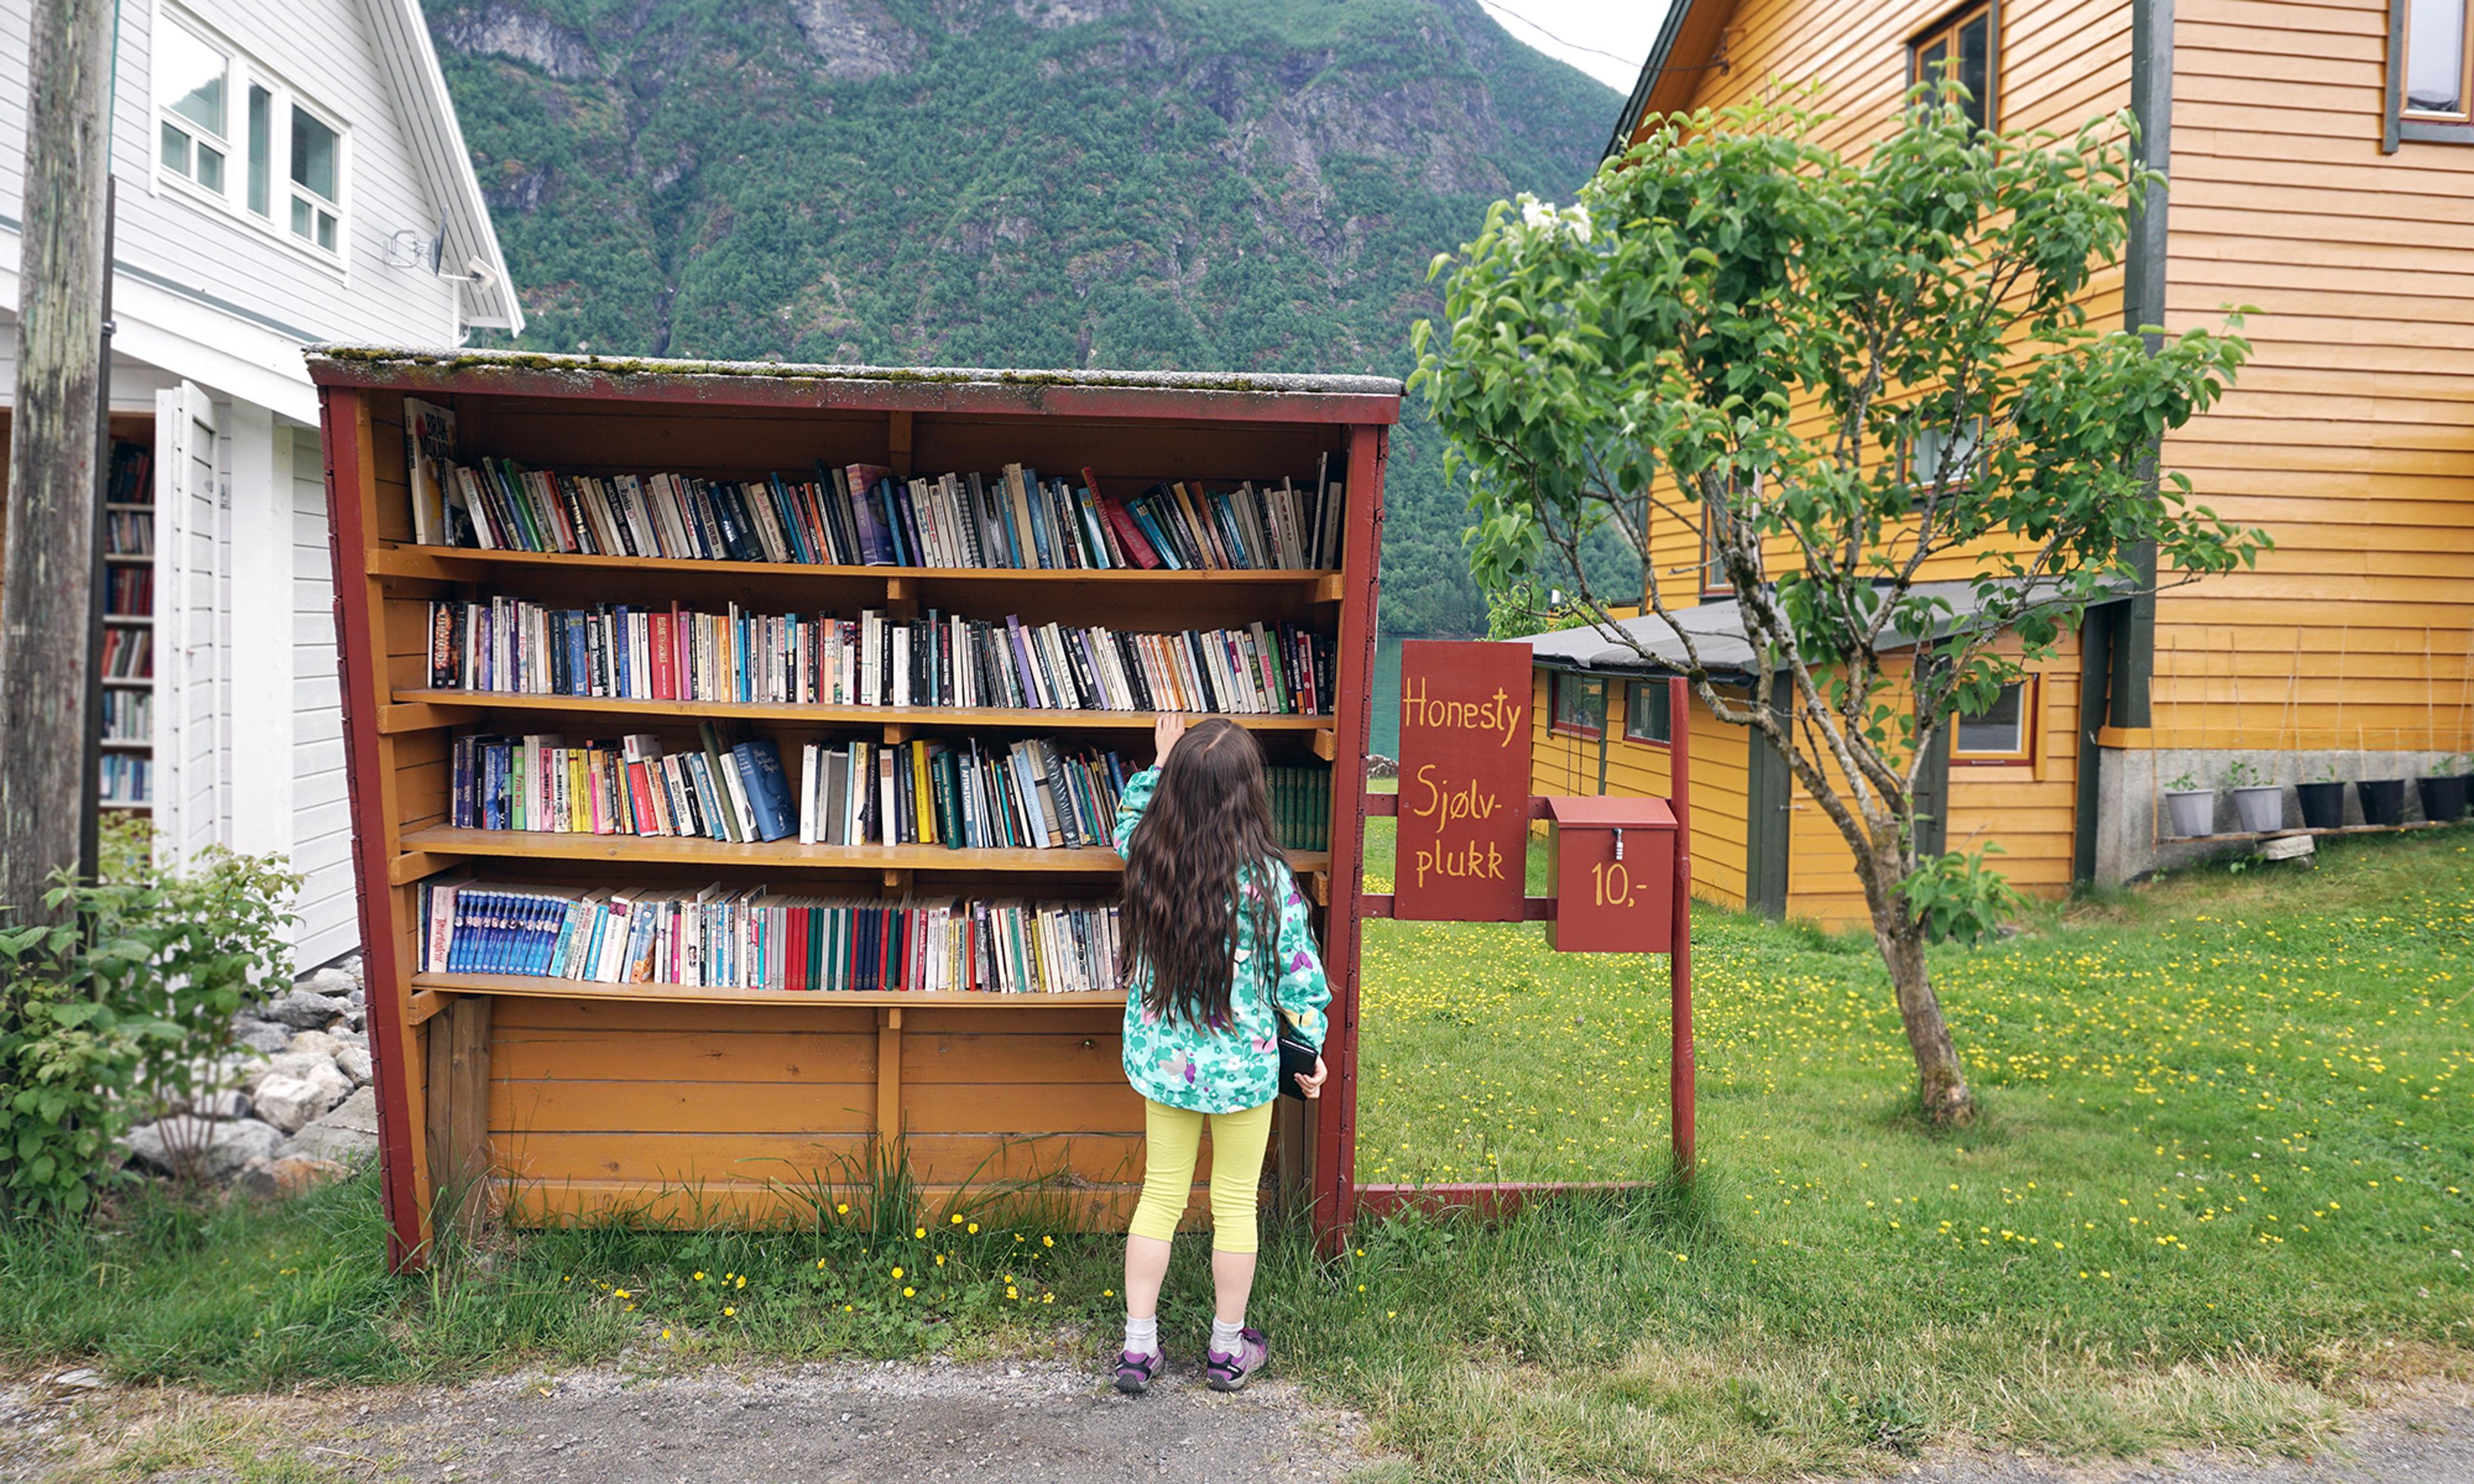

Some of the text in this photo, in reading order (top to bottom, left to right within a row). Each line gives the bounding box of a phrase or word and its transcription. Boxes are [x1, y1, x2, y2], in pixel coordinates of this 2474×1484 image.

[1403, 677, 1521, 747] Honesty
[1414, 765, 1502, 833] Sjølv-
[1416, 839, 1505, 888] plukk
[1591, 862, 1647, 908] 10,-
